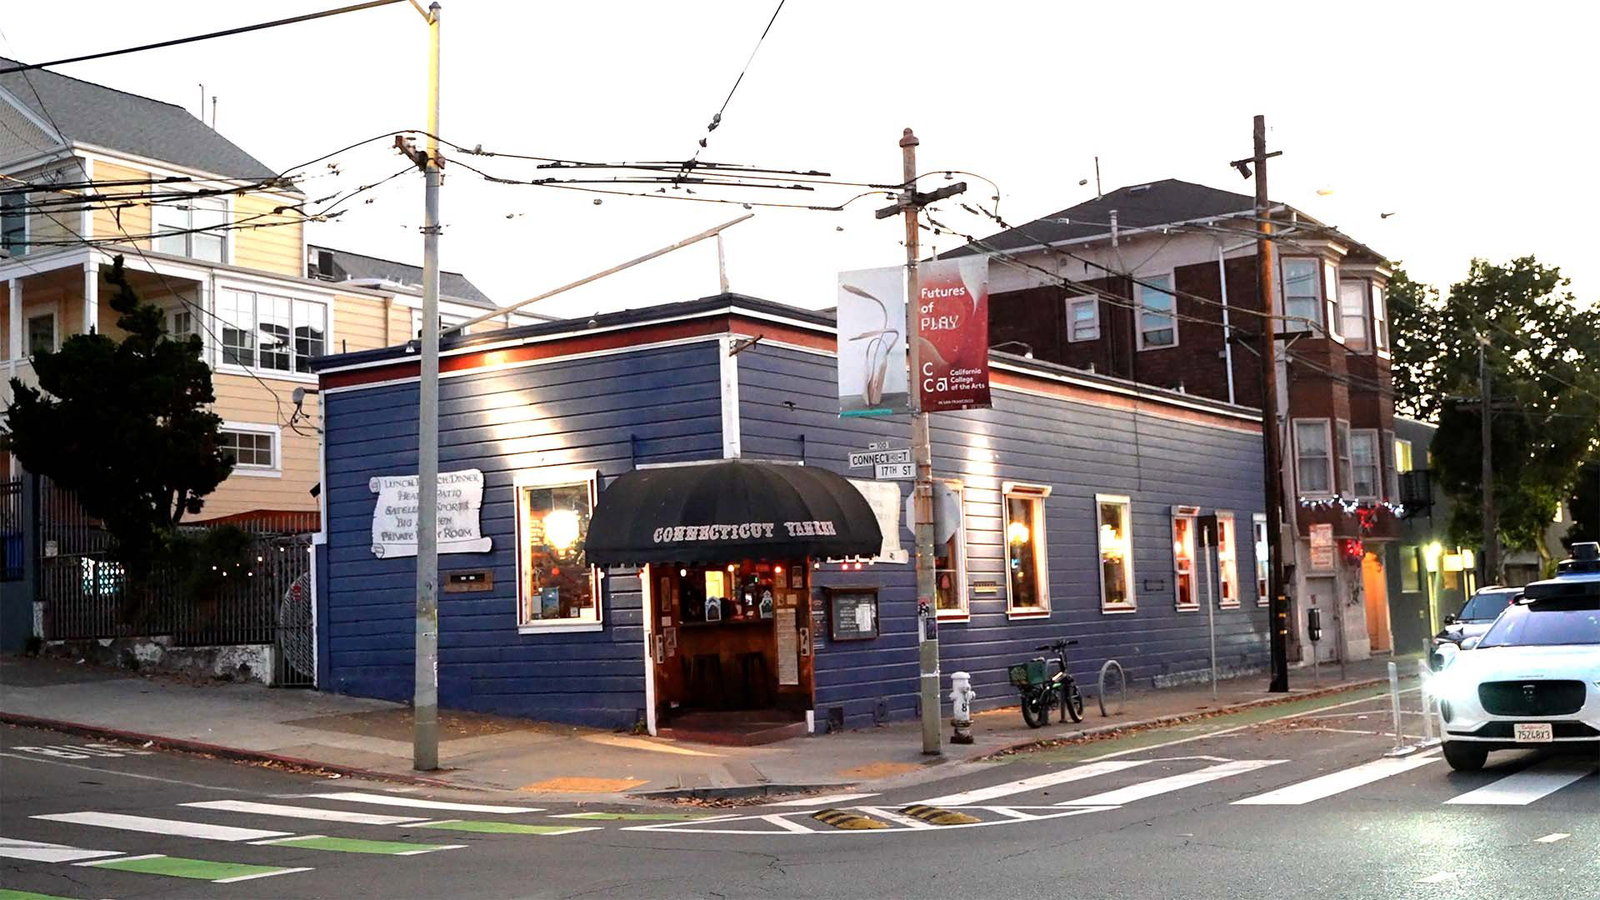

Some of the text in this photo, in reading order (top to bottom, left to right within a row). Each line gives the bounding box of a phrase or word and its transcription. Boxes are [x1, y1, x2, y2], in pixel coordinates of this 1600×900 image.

[921, 287, 966, 299] Futures
[921, 302, 934, 313] of
[921, 315, 959, 331] PLAY
[950, 368, 982, 376] California
[950, 376, 973, 384] College
[852, 452, 907, 465] CONNECTT
[881, 465, 912, 477] 17TH ST
[397, 490, 419, 501] HEA
[384, 505, 419, 516] SATELL
[395, 517, 413, 528] BIG
[444, 528, 472, 539] ROOM
[653, 523, 774, 543] CONNECTICUT
[962, 703, 967, 712] 8
